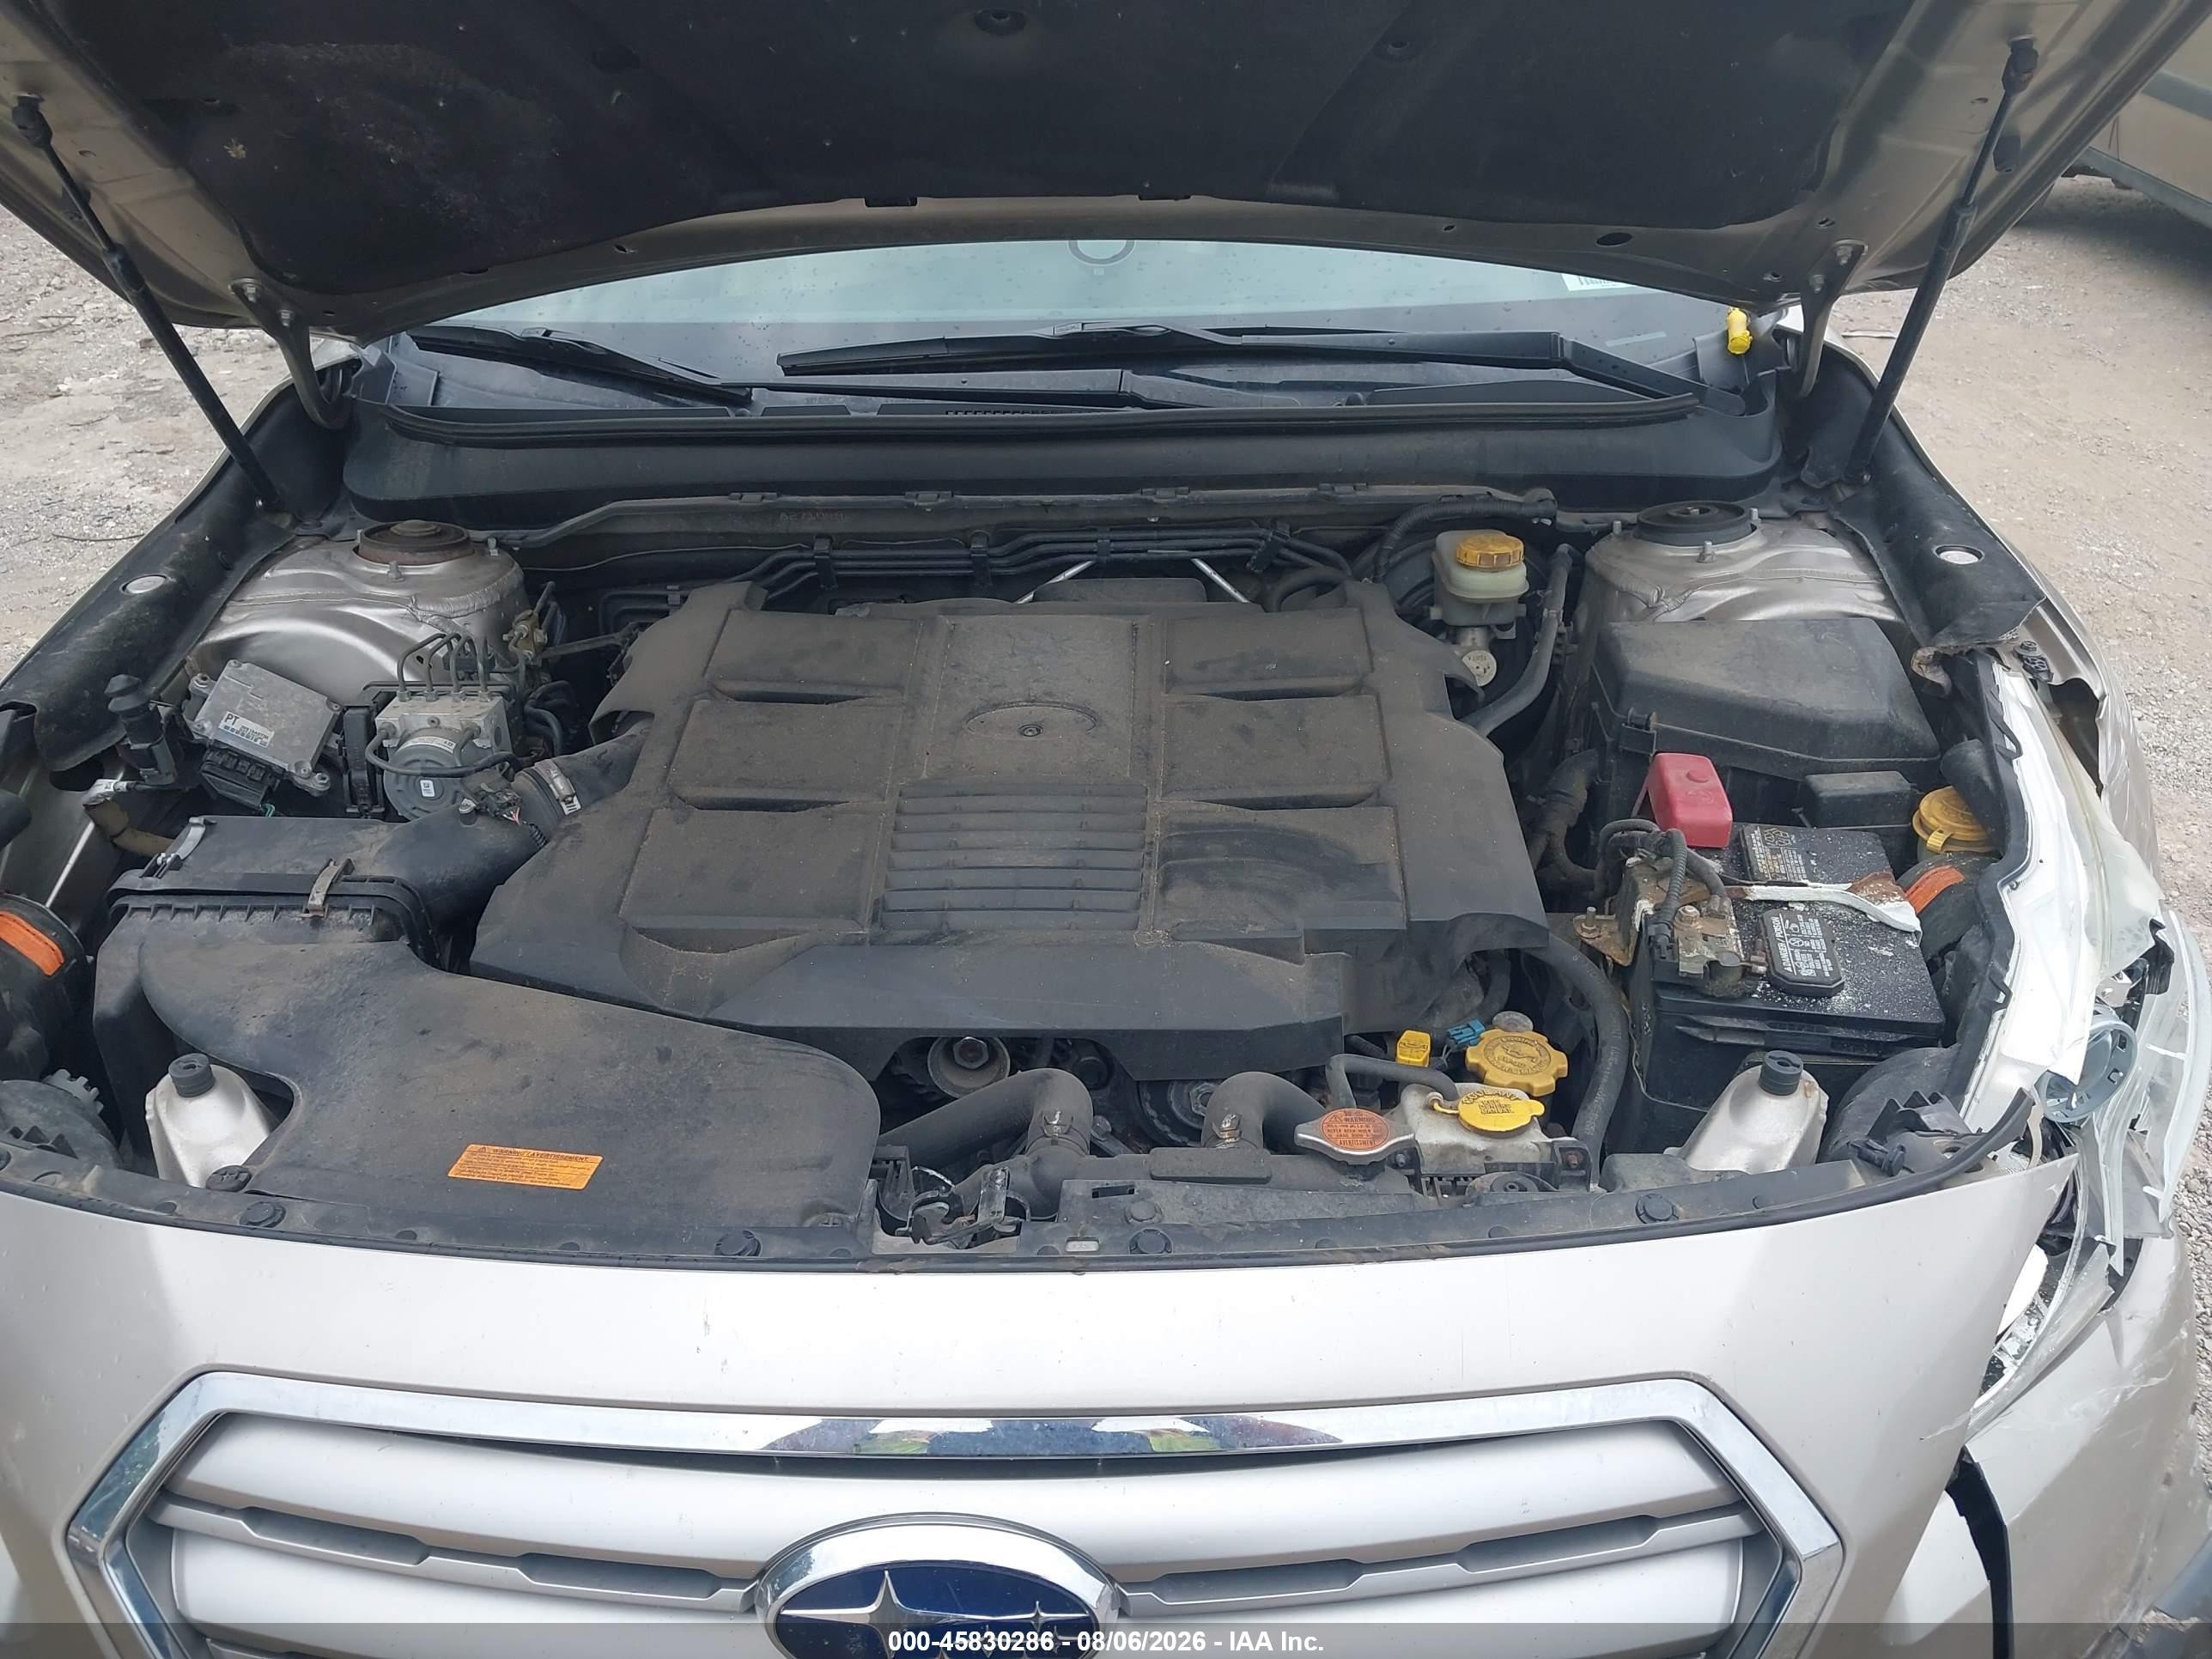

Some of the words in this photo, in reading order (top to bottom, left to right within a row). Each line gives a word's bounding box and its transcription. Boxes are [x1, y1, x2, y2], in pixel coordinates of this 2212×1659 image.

[224, 713, 240, 726] PT
[1771, 916, 1785, 938] POISON
[1778, 943, 1792, 967] DANGER
[1462, 1090, 1522, 1105] COOLANT
[493, 1148, 525, 1157] WARNING
